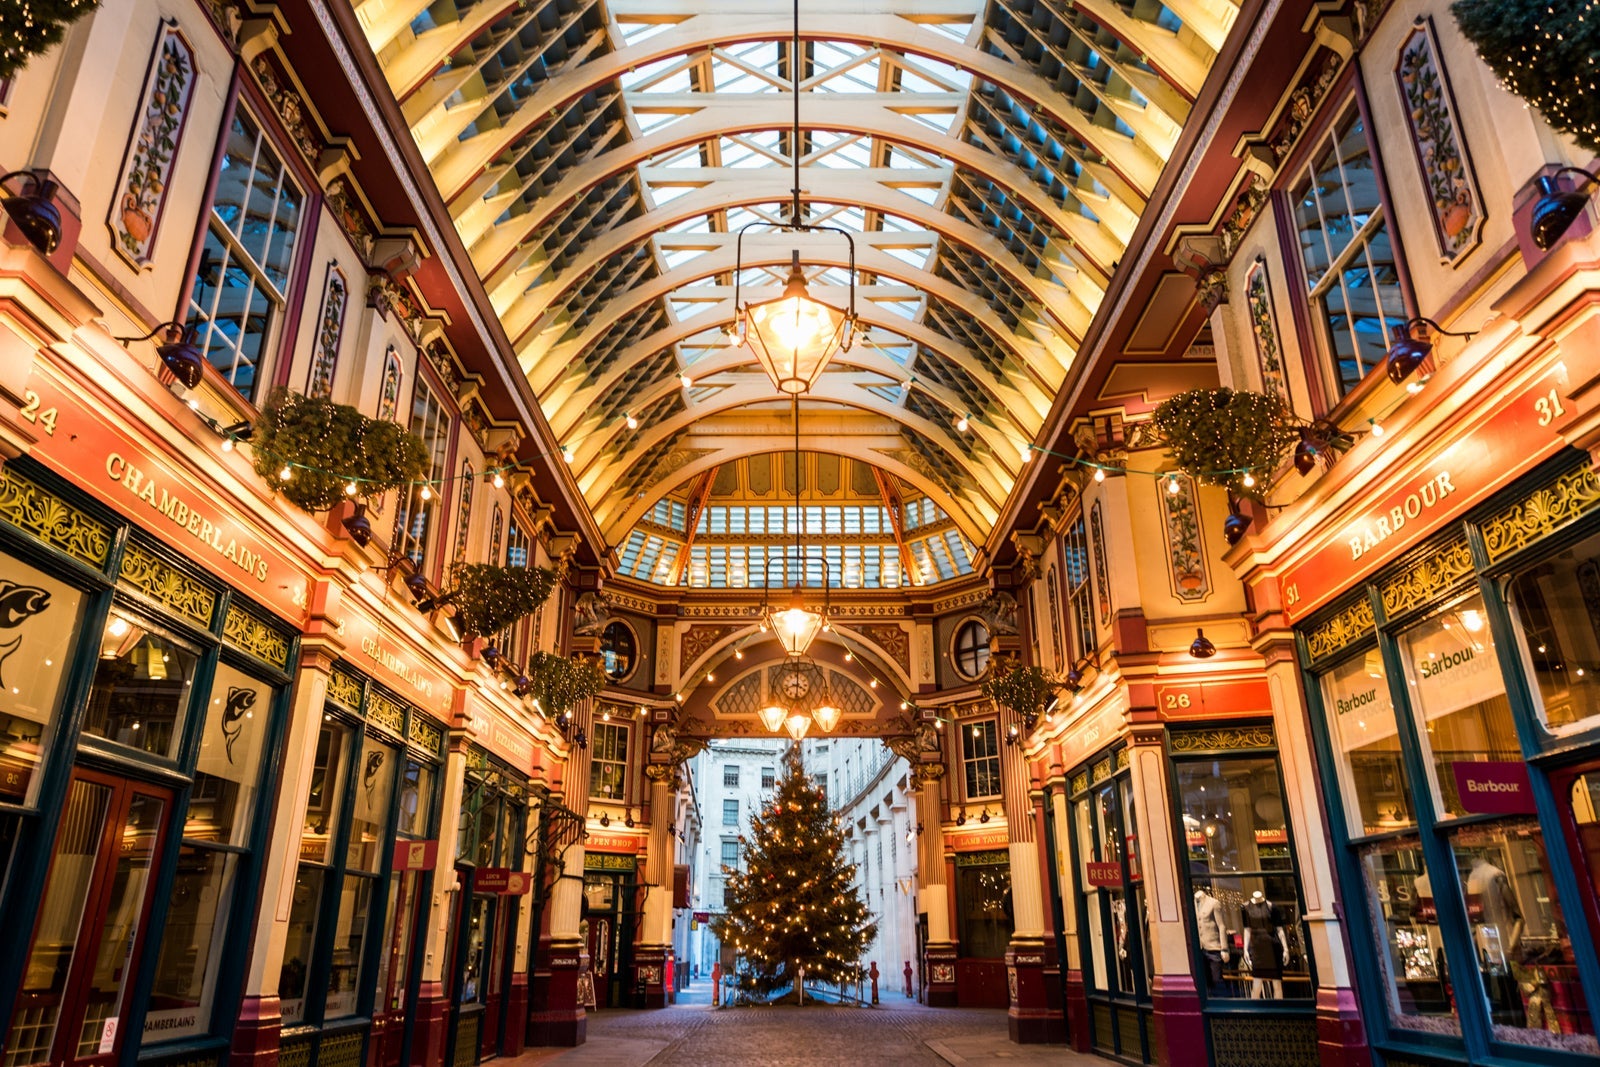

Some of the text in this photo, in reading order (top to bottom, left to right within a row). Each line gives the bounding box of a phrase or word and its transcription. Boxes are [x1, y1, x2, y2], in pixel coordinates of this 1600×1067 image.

[20, 391, 58, 435] 24
[1534, 388, 1566, 427] 31
[106, 452, 268, 582] CHAMBERLAIN'S
[1349, 471, 1457, 560] BARBOUR
[292, 586, 308, 610] 24
[1286, 583, 1300, 606] 31
[361, 636, 432, 698] CHAMBERLAIN'S
[1421, 647, 1475, 680] Barbour
[1166, 693, 1191, 709] 26
[1337, 687, 1377, 715] Barbour
[594, 837, 610, 845] PEN
[612, 839, 633, 847] SHOP
[1090, 868, 1120, 880] REISS
